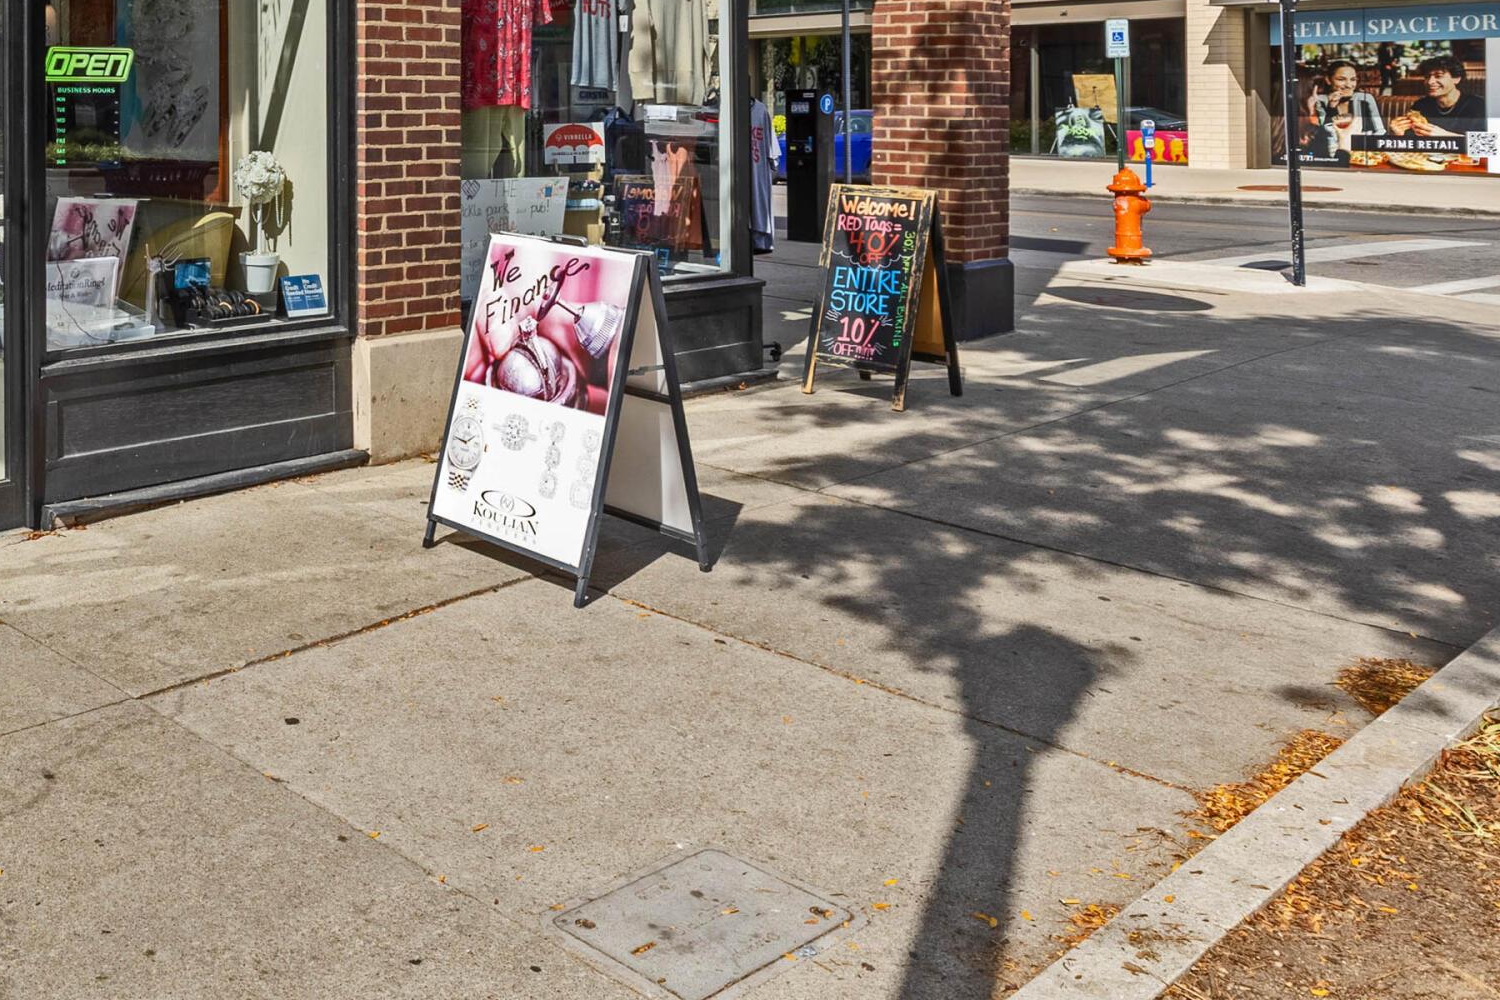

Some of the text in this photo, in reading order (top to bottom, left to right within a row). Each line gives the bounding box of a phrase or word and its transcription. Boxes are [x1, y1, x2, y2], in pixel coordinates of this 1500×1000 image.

[1367, 16, 1440, 36] SPACE
[1448, 13, 1499, 32] FOR
[47, 53, 128, 76] OPEN
[1377, 139, 1459, 150] PRIME RETAIL
[491, 179, 519, 198] THE
[841, 194, 916, 220] Welcome!
[837, 213, 862, 231] RED
[850, 231, 900, 256] 40%
[902, 231, 916, 252] 30%
[490, 248, 522, 292] We
[860, 253, 883, 264] OFF
[832, 266, 901, 295] ENTIRE
[484, 257, 590, 335] Finance
[830, 289, 890, 316] STORE
[837, 316, 880, 348] 10%
[472, 500, 540, 536] KOULIAN
